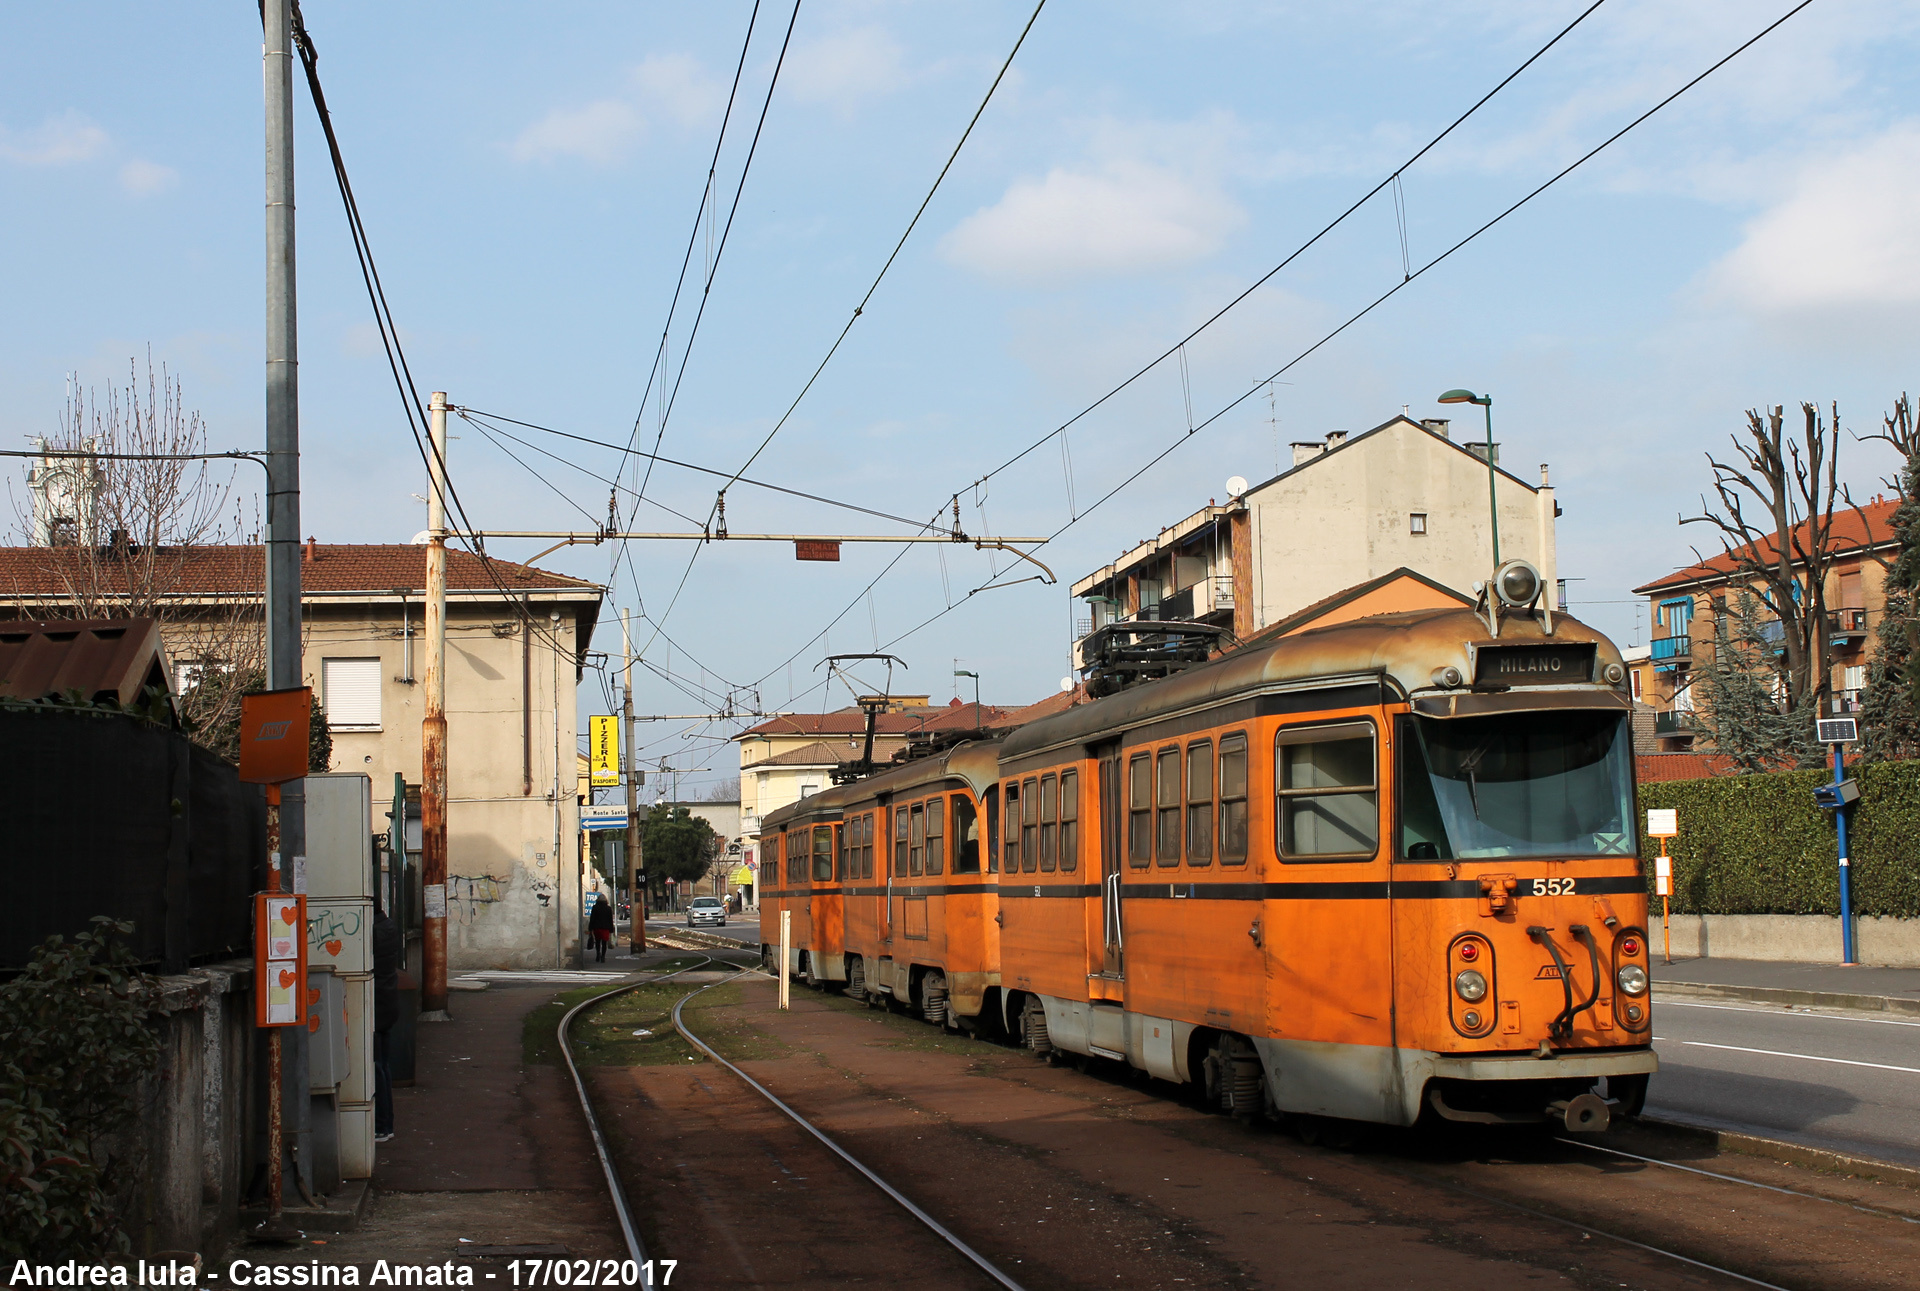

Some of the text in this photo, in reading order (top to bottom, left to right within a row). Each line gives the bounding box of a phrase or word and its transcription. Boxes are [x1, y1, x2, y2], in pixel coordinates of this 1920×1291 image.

[1500, 658, 1561, 672] MILANO
[265, 725, 282, 737] ATM
[1532, 877, 1576, 896] 552
